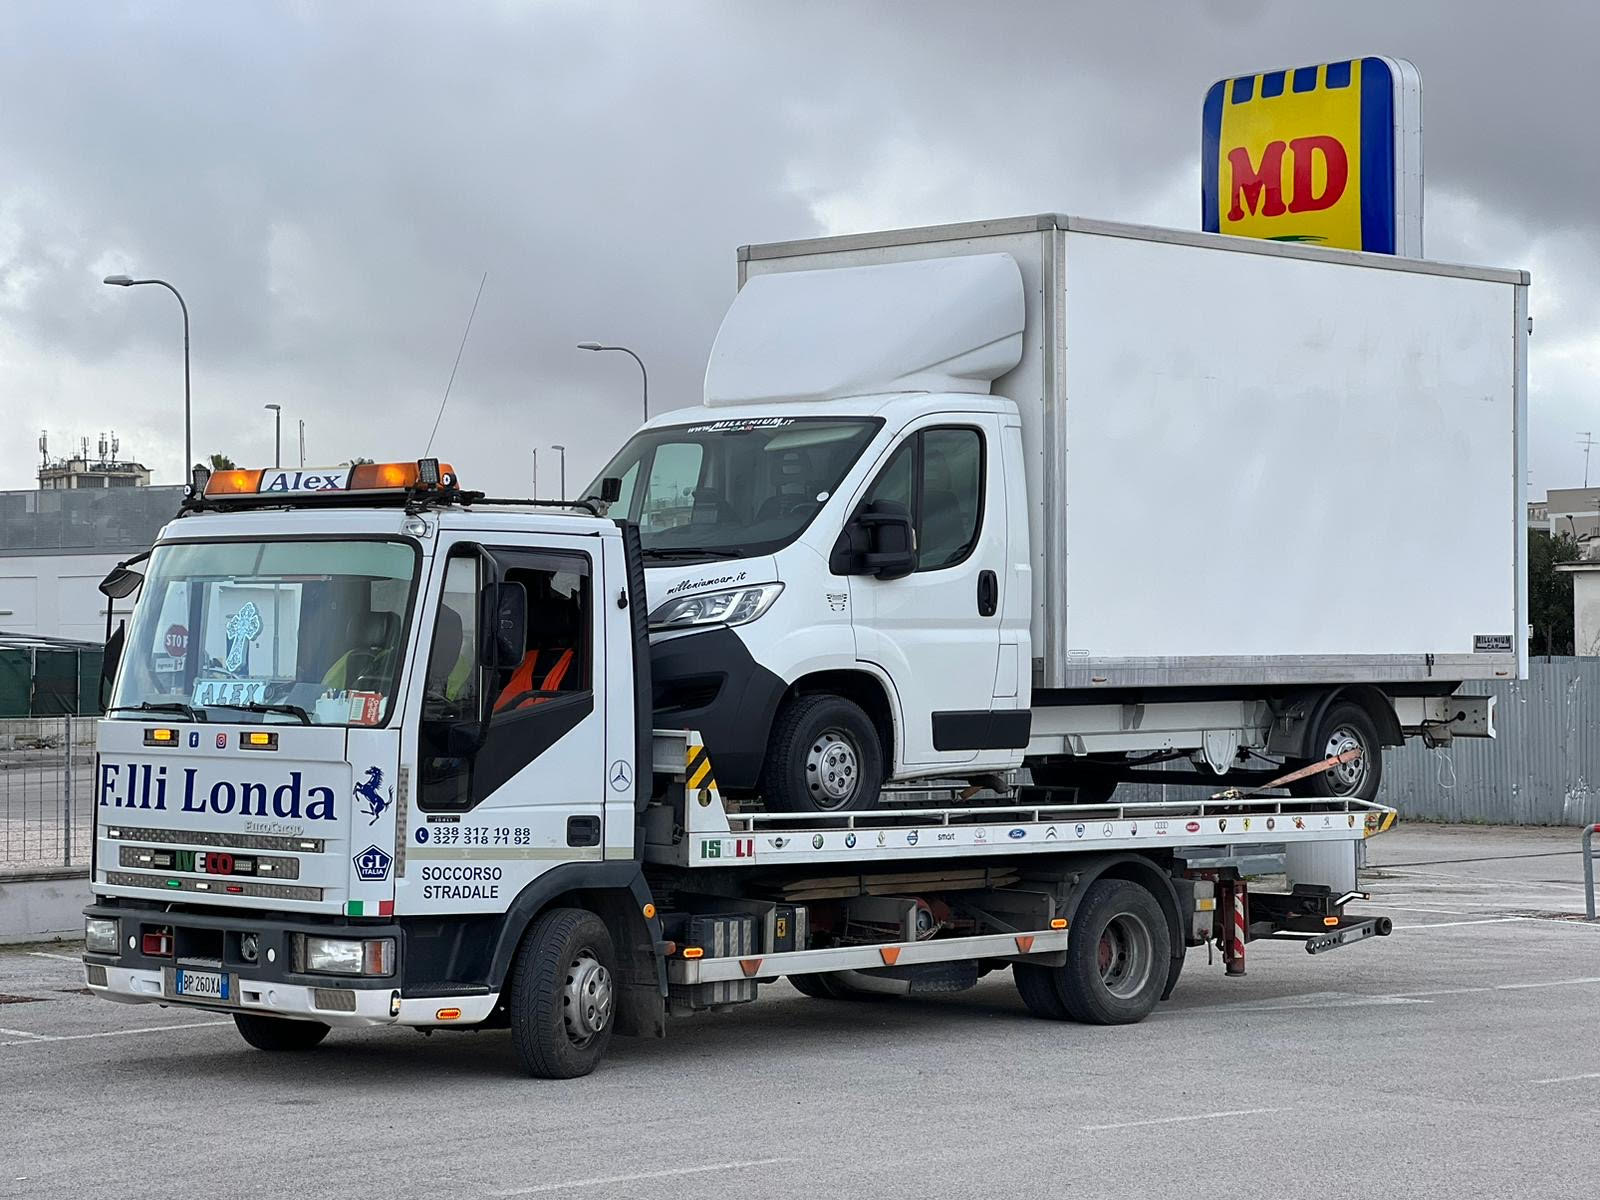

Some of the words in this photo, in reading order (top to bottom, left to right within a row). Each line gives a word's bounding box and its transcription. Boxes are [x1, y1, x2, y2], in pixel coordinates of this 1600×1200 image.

[1227, 135, 1349, 221] MD
[267, 472, 341, 490] Alex
[666, 571, 746, 595] milleniumcar.it
[201, 683, 260, 705] ALEX
[100, 763, 167, 810] F.lli
[181, 768, 337, 821] Londa
[433, 827, 459, 836] 338
[464, 827, 489, 836] 317
[494, 828, 510, 836] 10
[514, 828, 531, 836] 88
[433, 836, 459, 844] 327
[464, 836, 489, 845] 318
[493, 836, 508, 845] 71
[514, 836, 531, 845] 92
[176, 850, 234, 875] IVECO
[359, 854, 387, 869] GL
[422, 866, 502, 880] SOCCORSO
[423, 885, 499, 899] STRADALE
[183, 974, 194, 991] BP
[195, 975, 221, 994] 260XA
